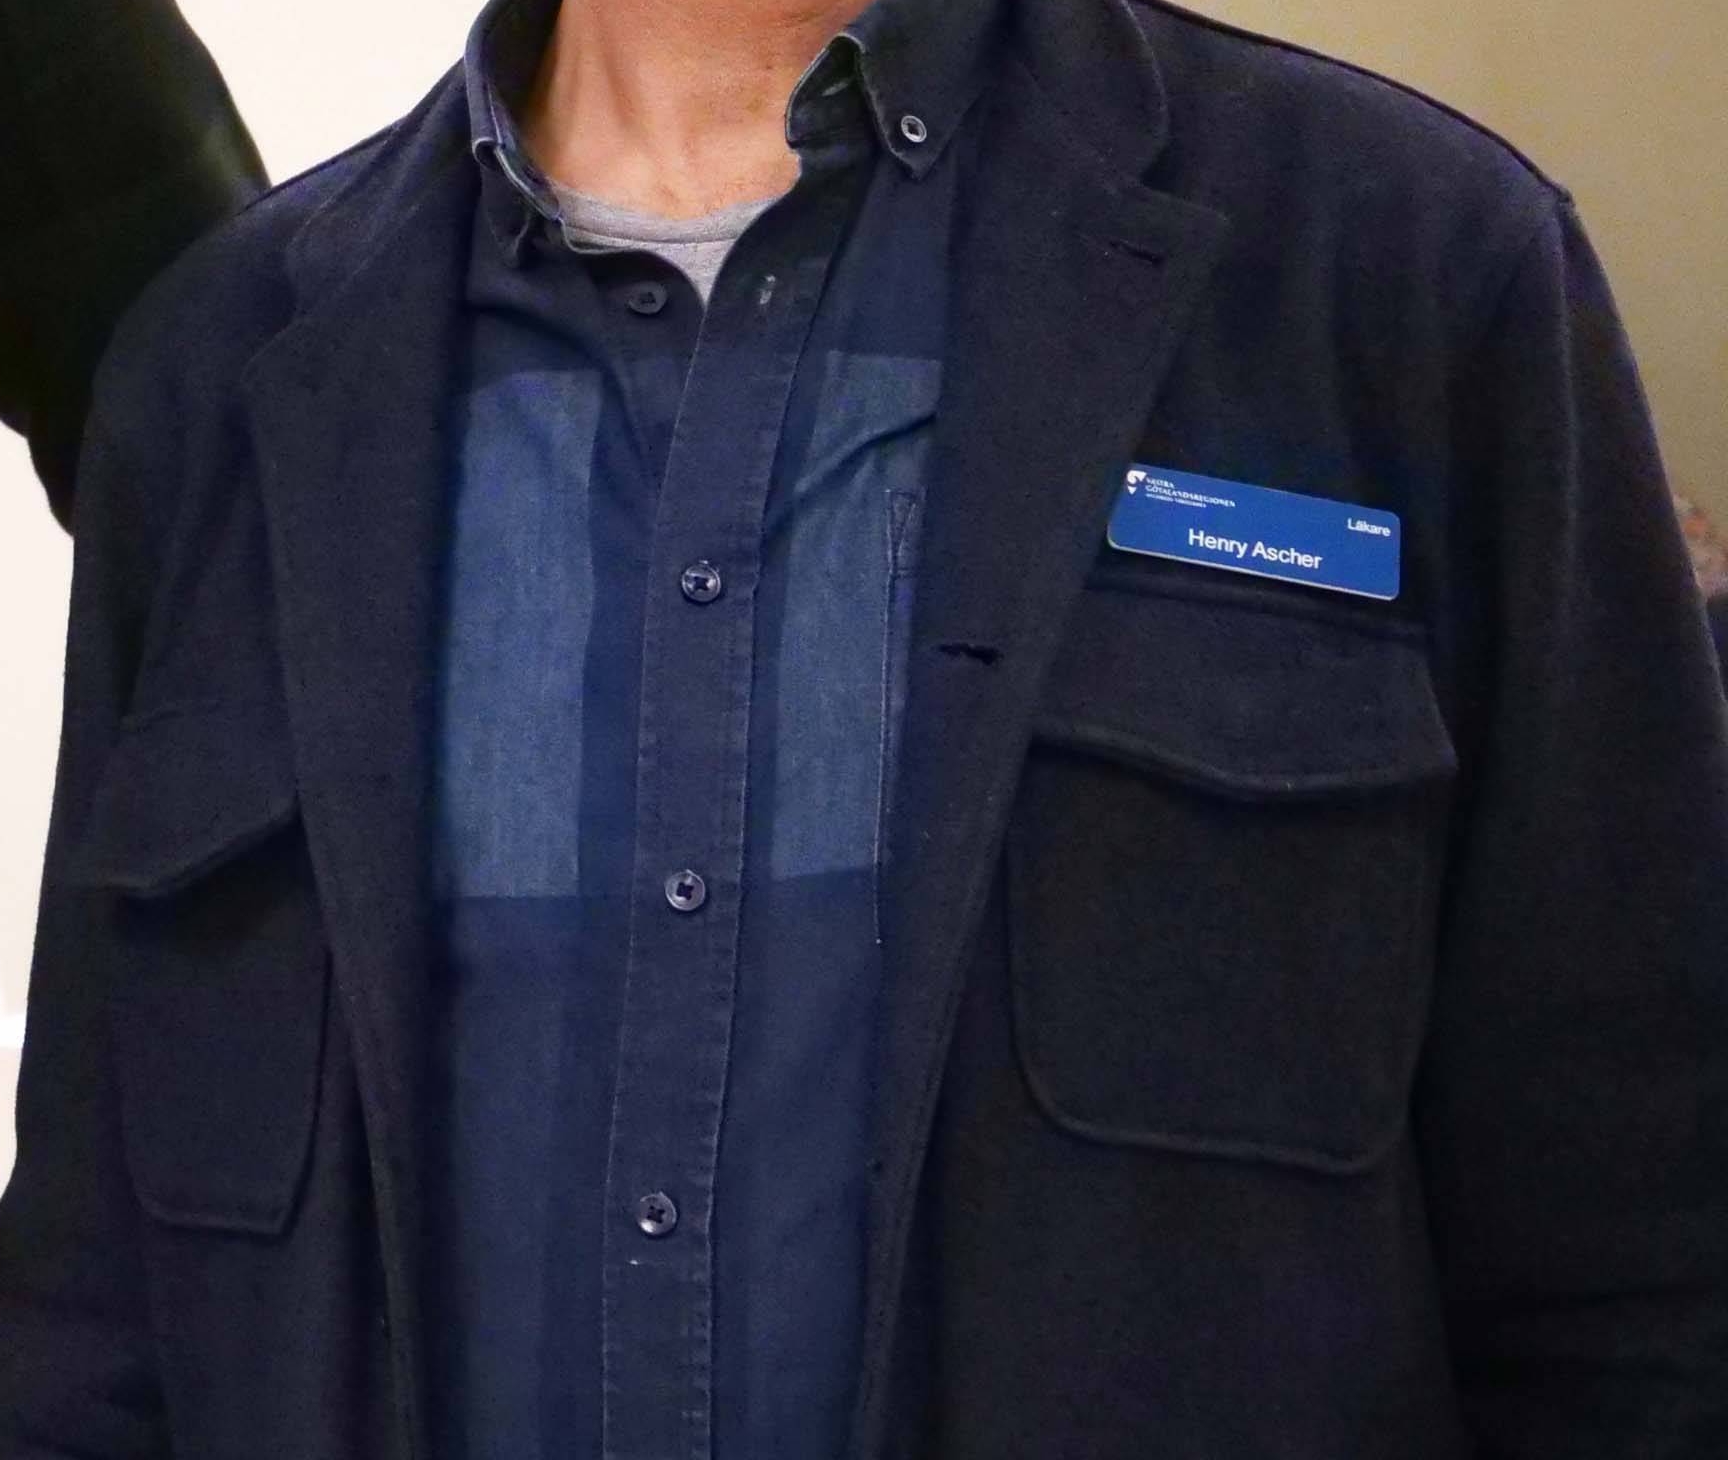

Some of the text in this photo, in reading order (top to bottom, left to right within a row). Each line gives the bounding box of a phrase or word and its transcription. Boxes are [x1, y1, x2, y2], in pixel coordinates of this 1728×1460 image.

[1347, 517, 1391, 537] Läkare
[1188, 528, 1323, 570] Henry Ascher
